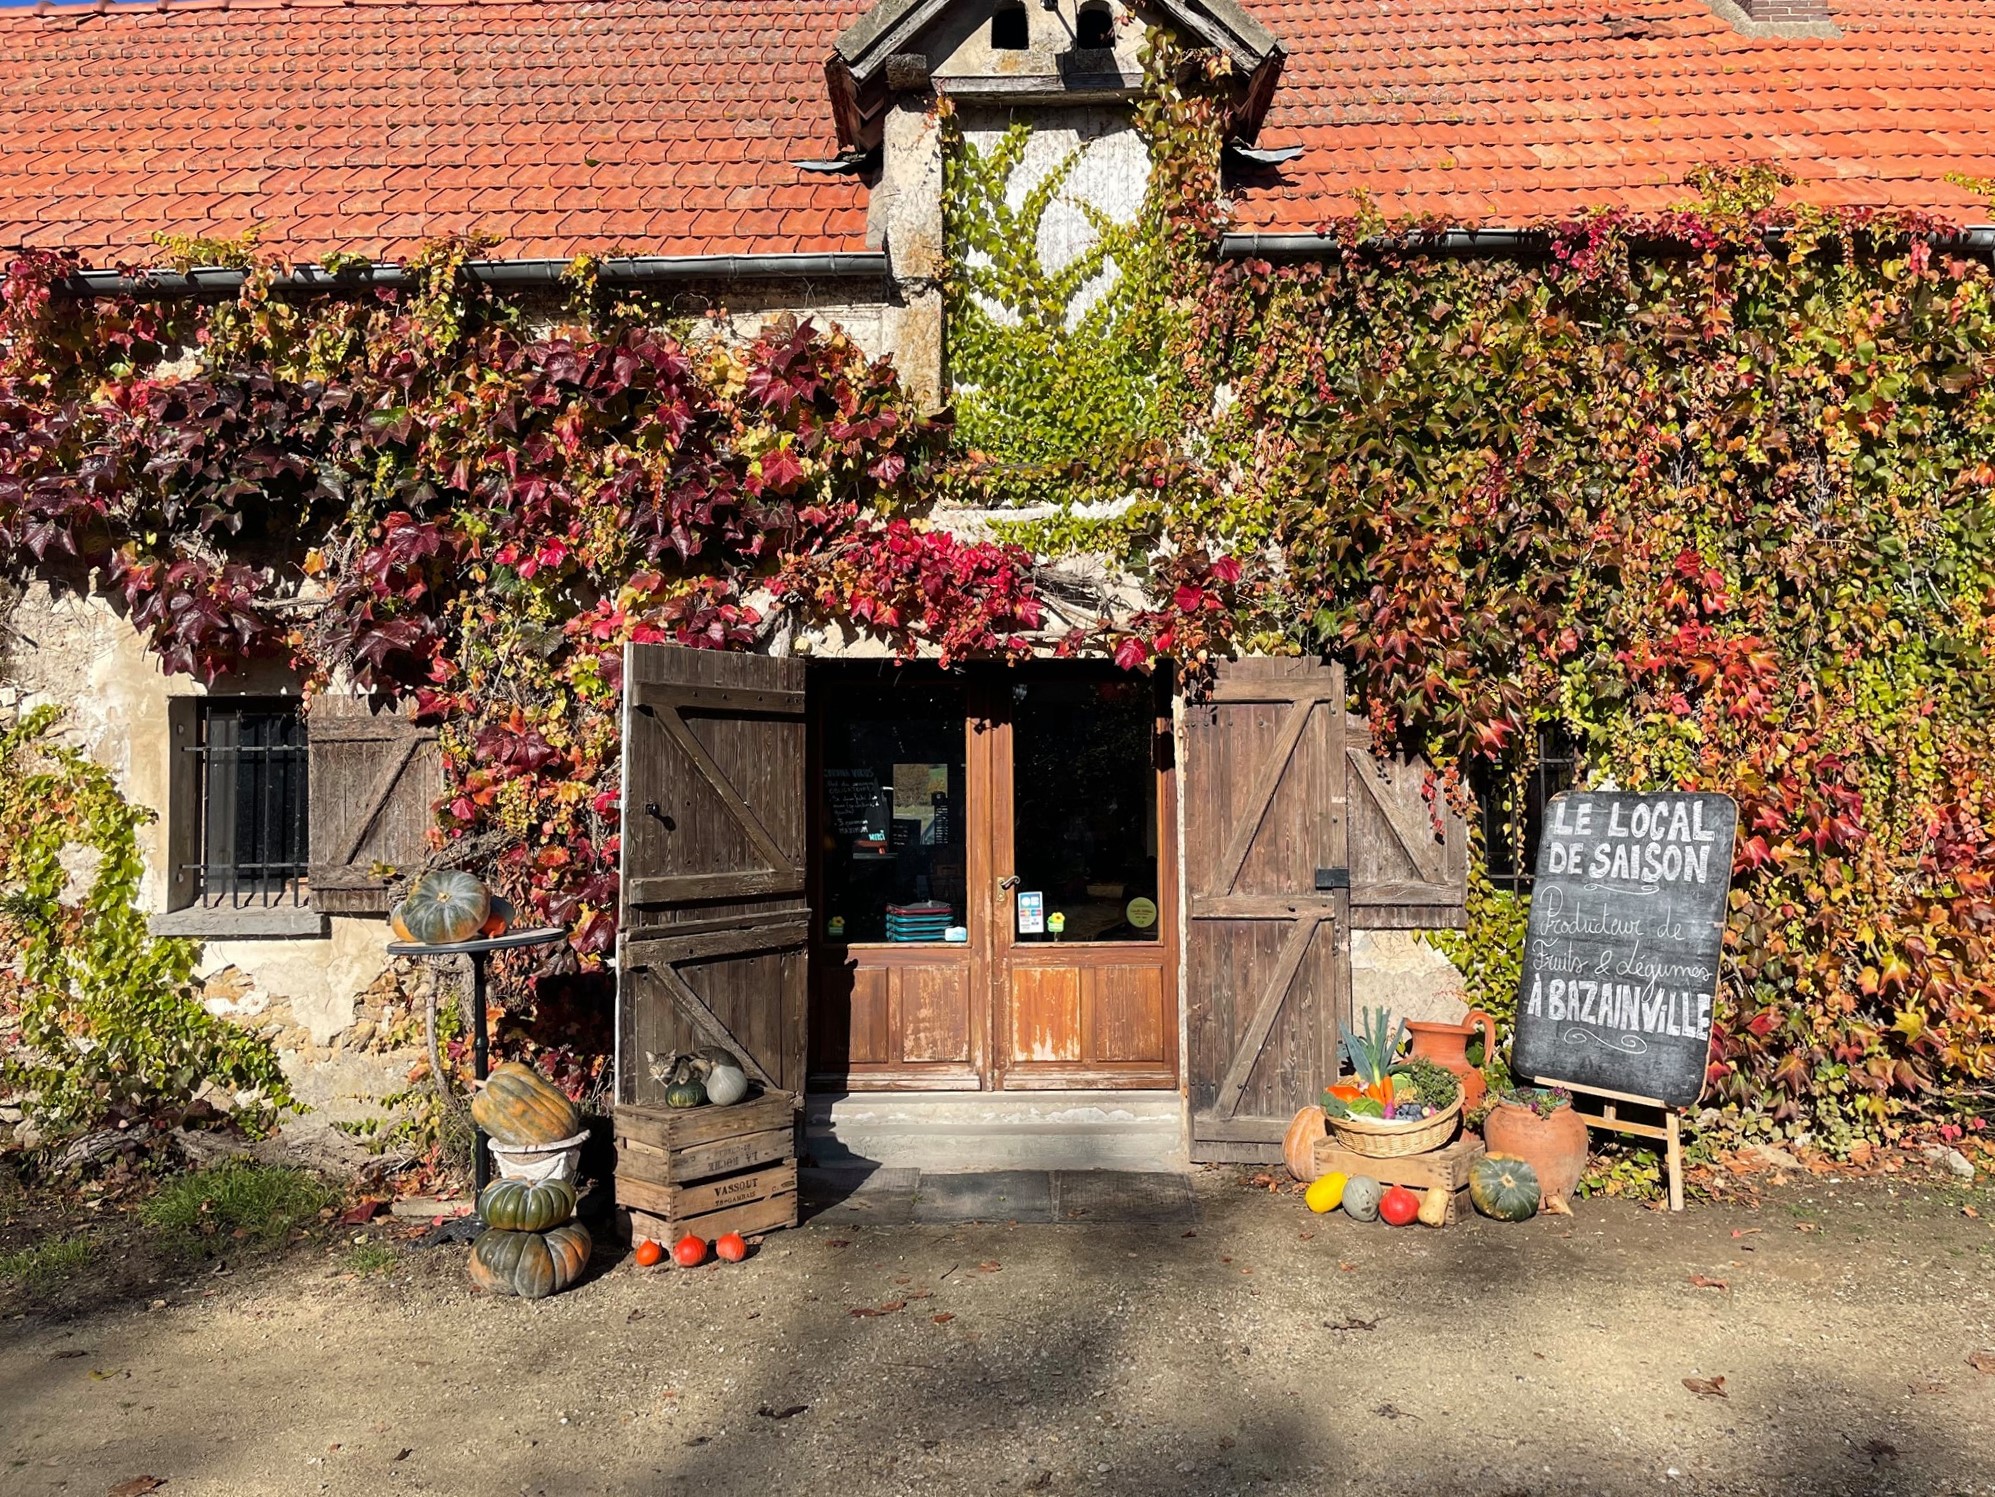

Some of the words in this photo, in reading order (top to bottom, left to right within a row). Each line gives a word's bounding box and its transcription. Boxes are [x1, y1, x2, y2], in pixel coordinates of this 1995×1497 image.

[1553, 802, 1592, 835] LE
[1607, 800, 1715, 842] LOCAL
[1548, 842, 1584, 874] DE
[1588, 841, 1711, 884] SAISON
[1539, 885, 1644, 935] Producteur
[1656, 905, 1685, 940] de
[1532, 937, 1588, 971] Fruits
[1594, 950, 1613, 976] &
[1616, 939, 1713, 1003] Légumes
[1526, 972, 1543, 1018] À
[714, 1178, 759, 1197] VASSOUT
